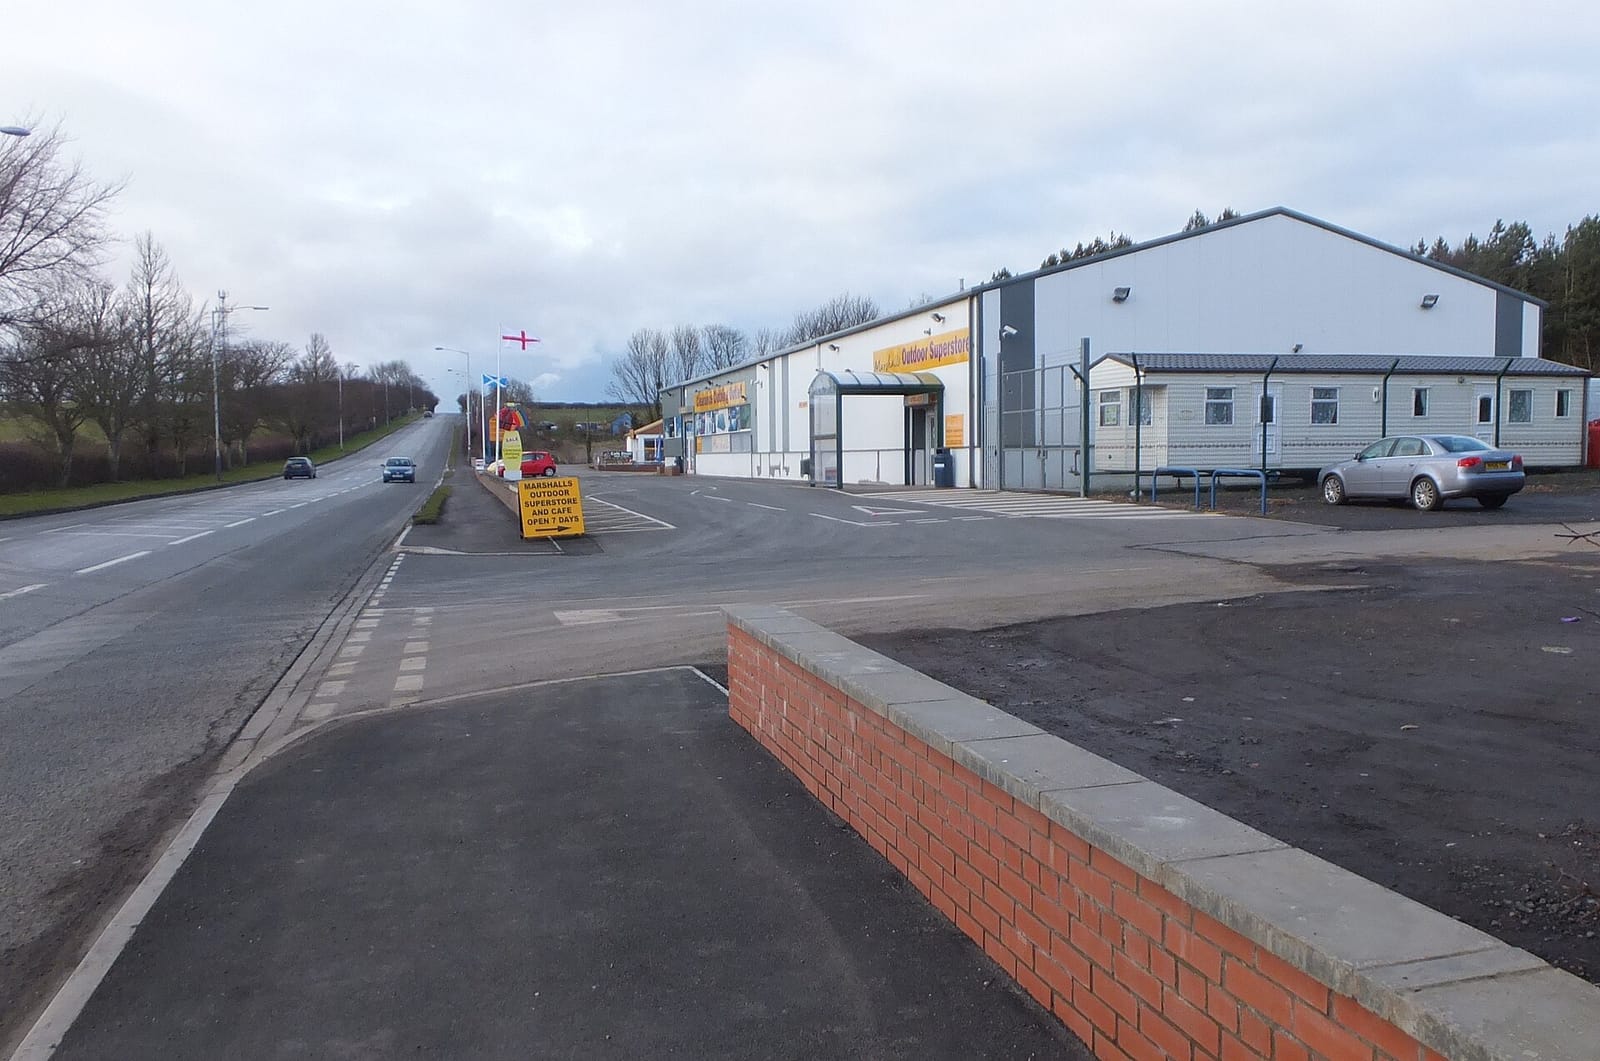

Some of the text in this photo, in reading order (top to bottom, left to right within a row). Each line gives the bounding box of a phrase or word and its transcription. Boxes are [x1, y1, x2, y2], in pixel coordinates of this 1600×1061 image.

[902, 345, 928, 365] Outdoor
[929, 335, 969, 362] Superstore
[524, 480, 573, 490] MARSHALLS
[530, 489, 570, 498] OUTDOOR
[524, 497, 578, 508] SUPERSTORE
[532, 507, 572, 516] AND CAFE
[527, 517, 550, 526] OPEN
[558, 515, 579, 524] DAYS
